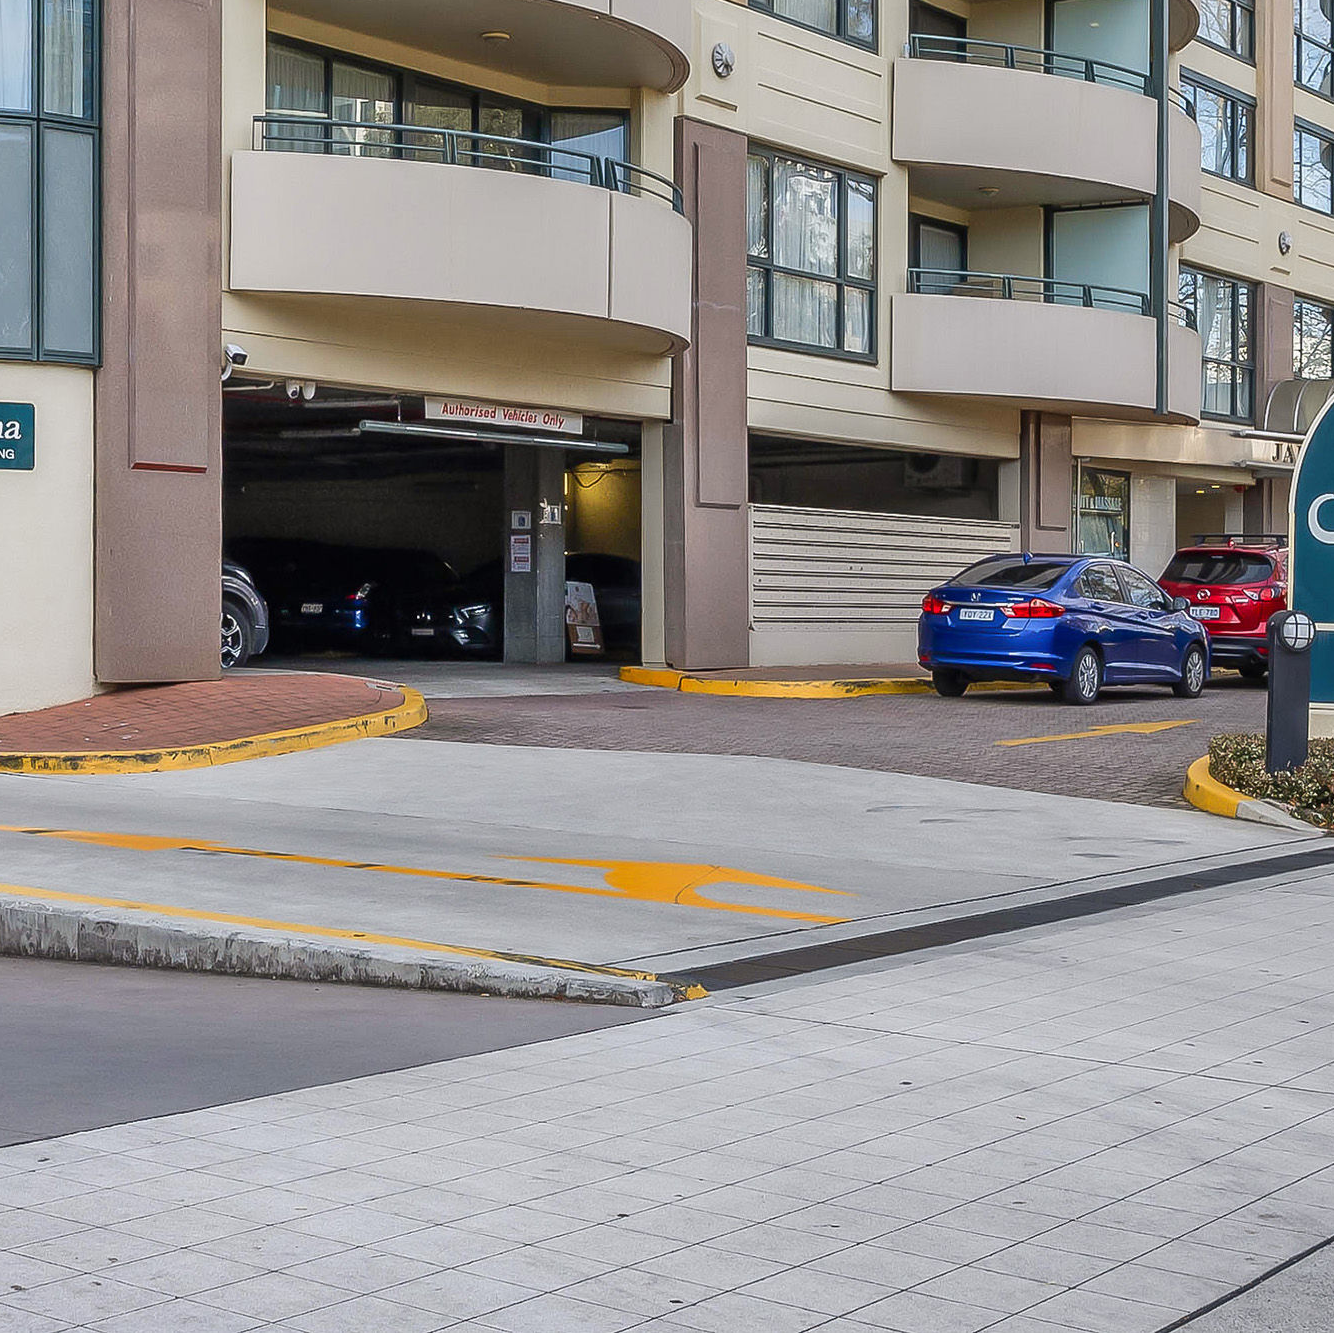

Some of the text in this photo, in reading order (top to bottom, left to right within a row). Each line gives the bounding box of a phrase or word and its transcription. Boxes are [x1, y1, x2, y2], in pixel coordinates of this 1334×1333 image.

[441, 402, 565, 429] Authorised Vehicles Only
